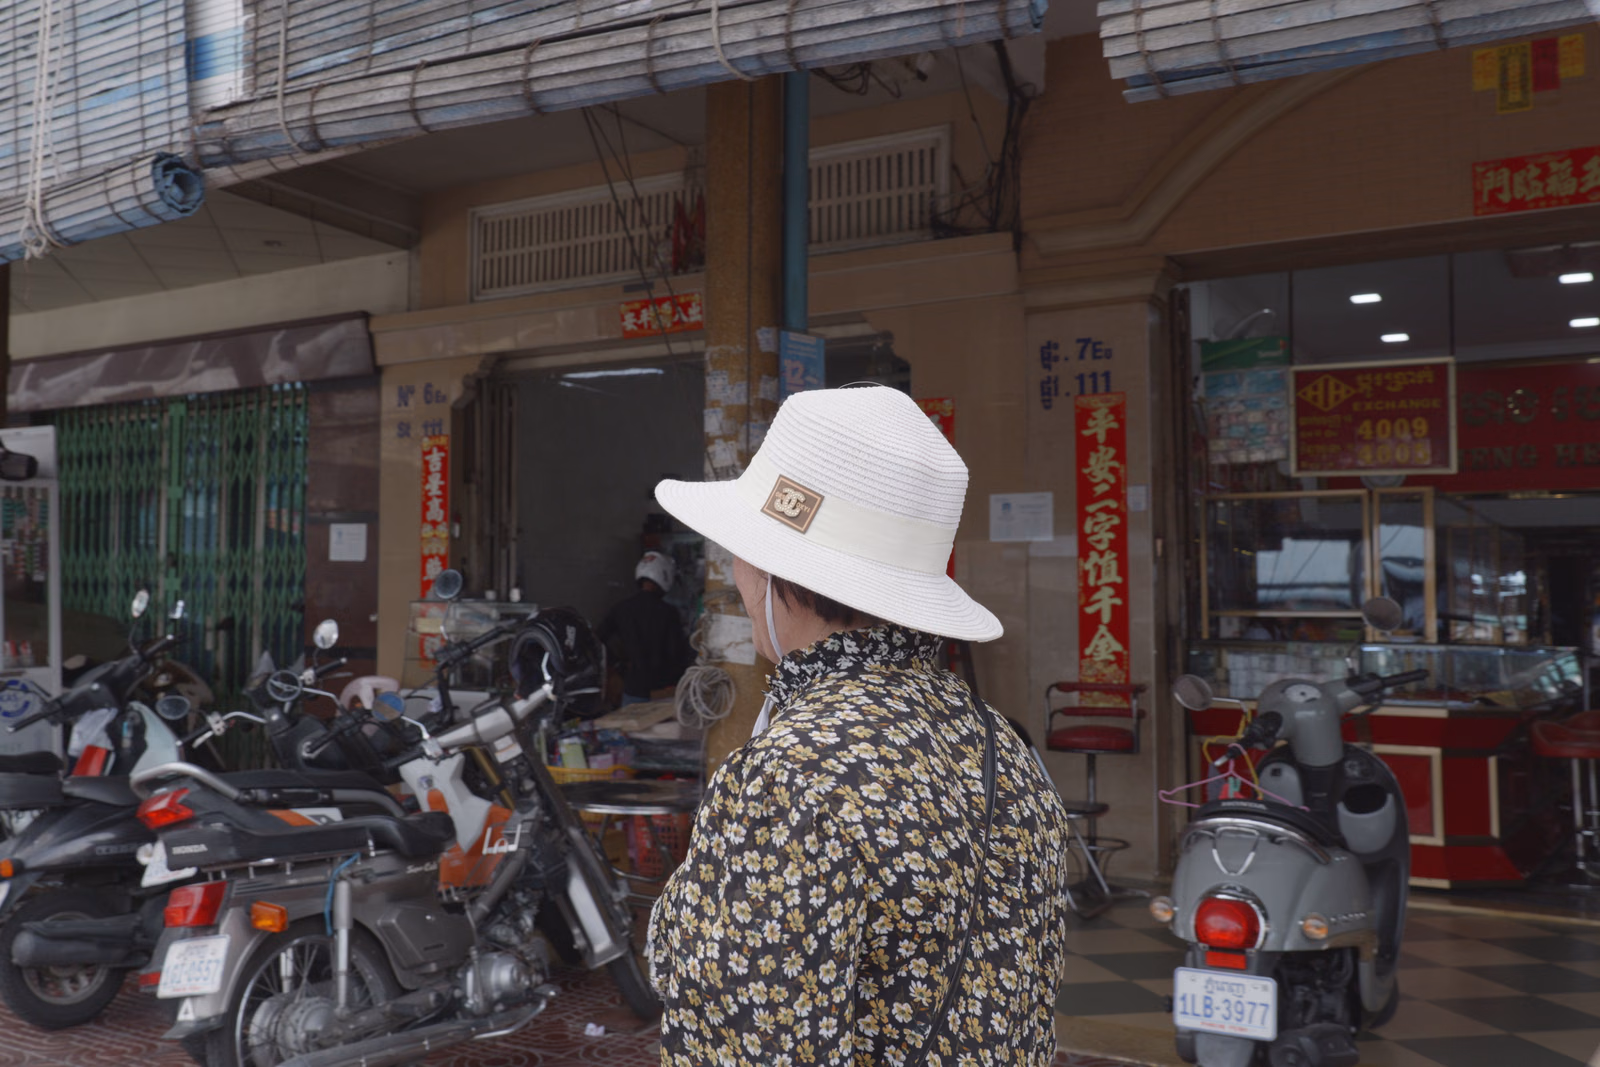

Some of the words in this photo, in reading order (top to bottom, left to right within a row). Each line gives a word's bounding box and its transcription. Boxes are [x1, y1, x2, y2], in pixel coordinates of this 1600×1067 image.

[1352, 399, 1441, 412] EXCHANGE
[1358, 417, 1428, 440] 4009
[1220, 801, 1267, 810] HONDA
[172, 844, 208, 855] HONDA
[1179, 993, 1270, 1026] 1LB-3977
